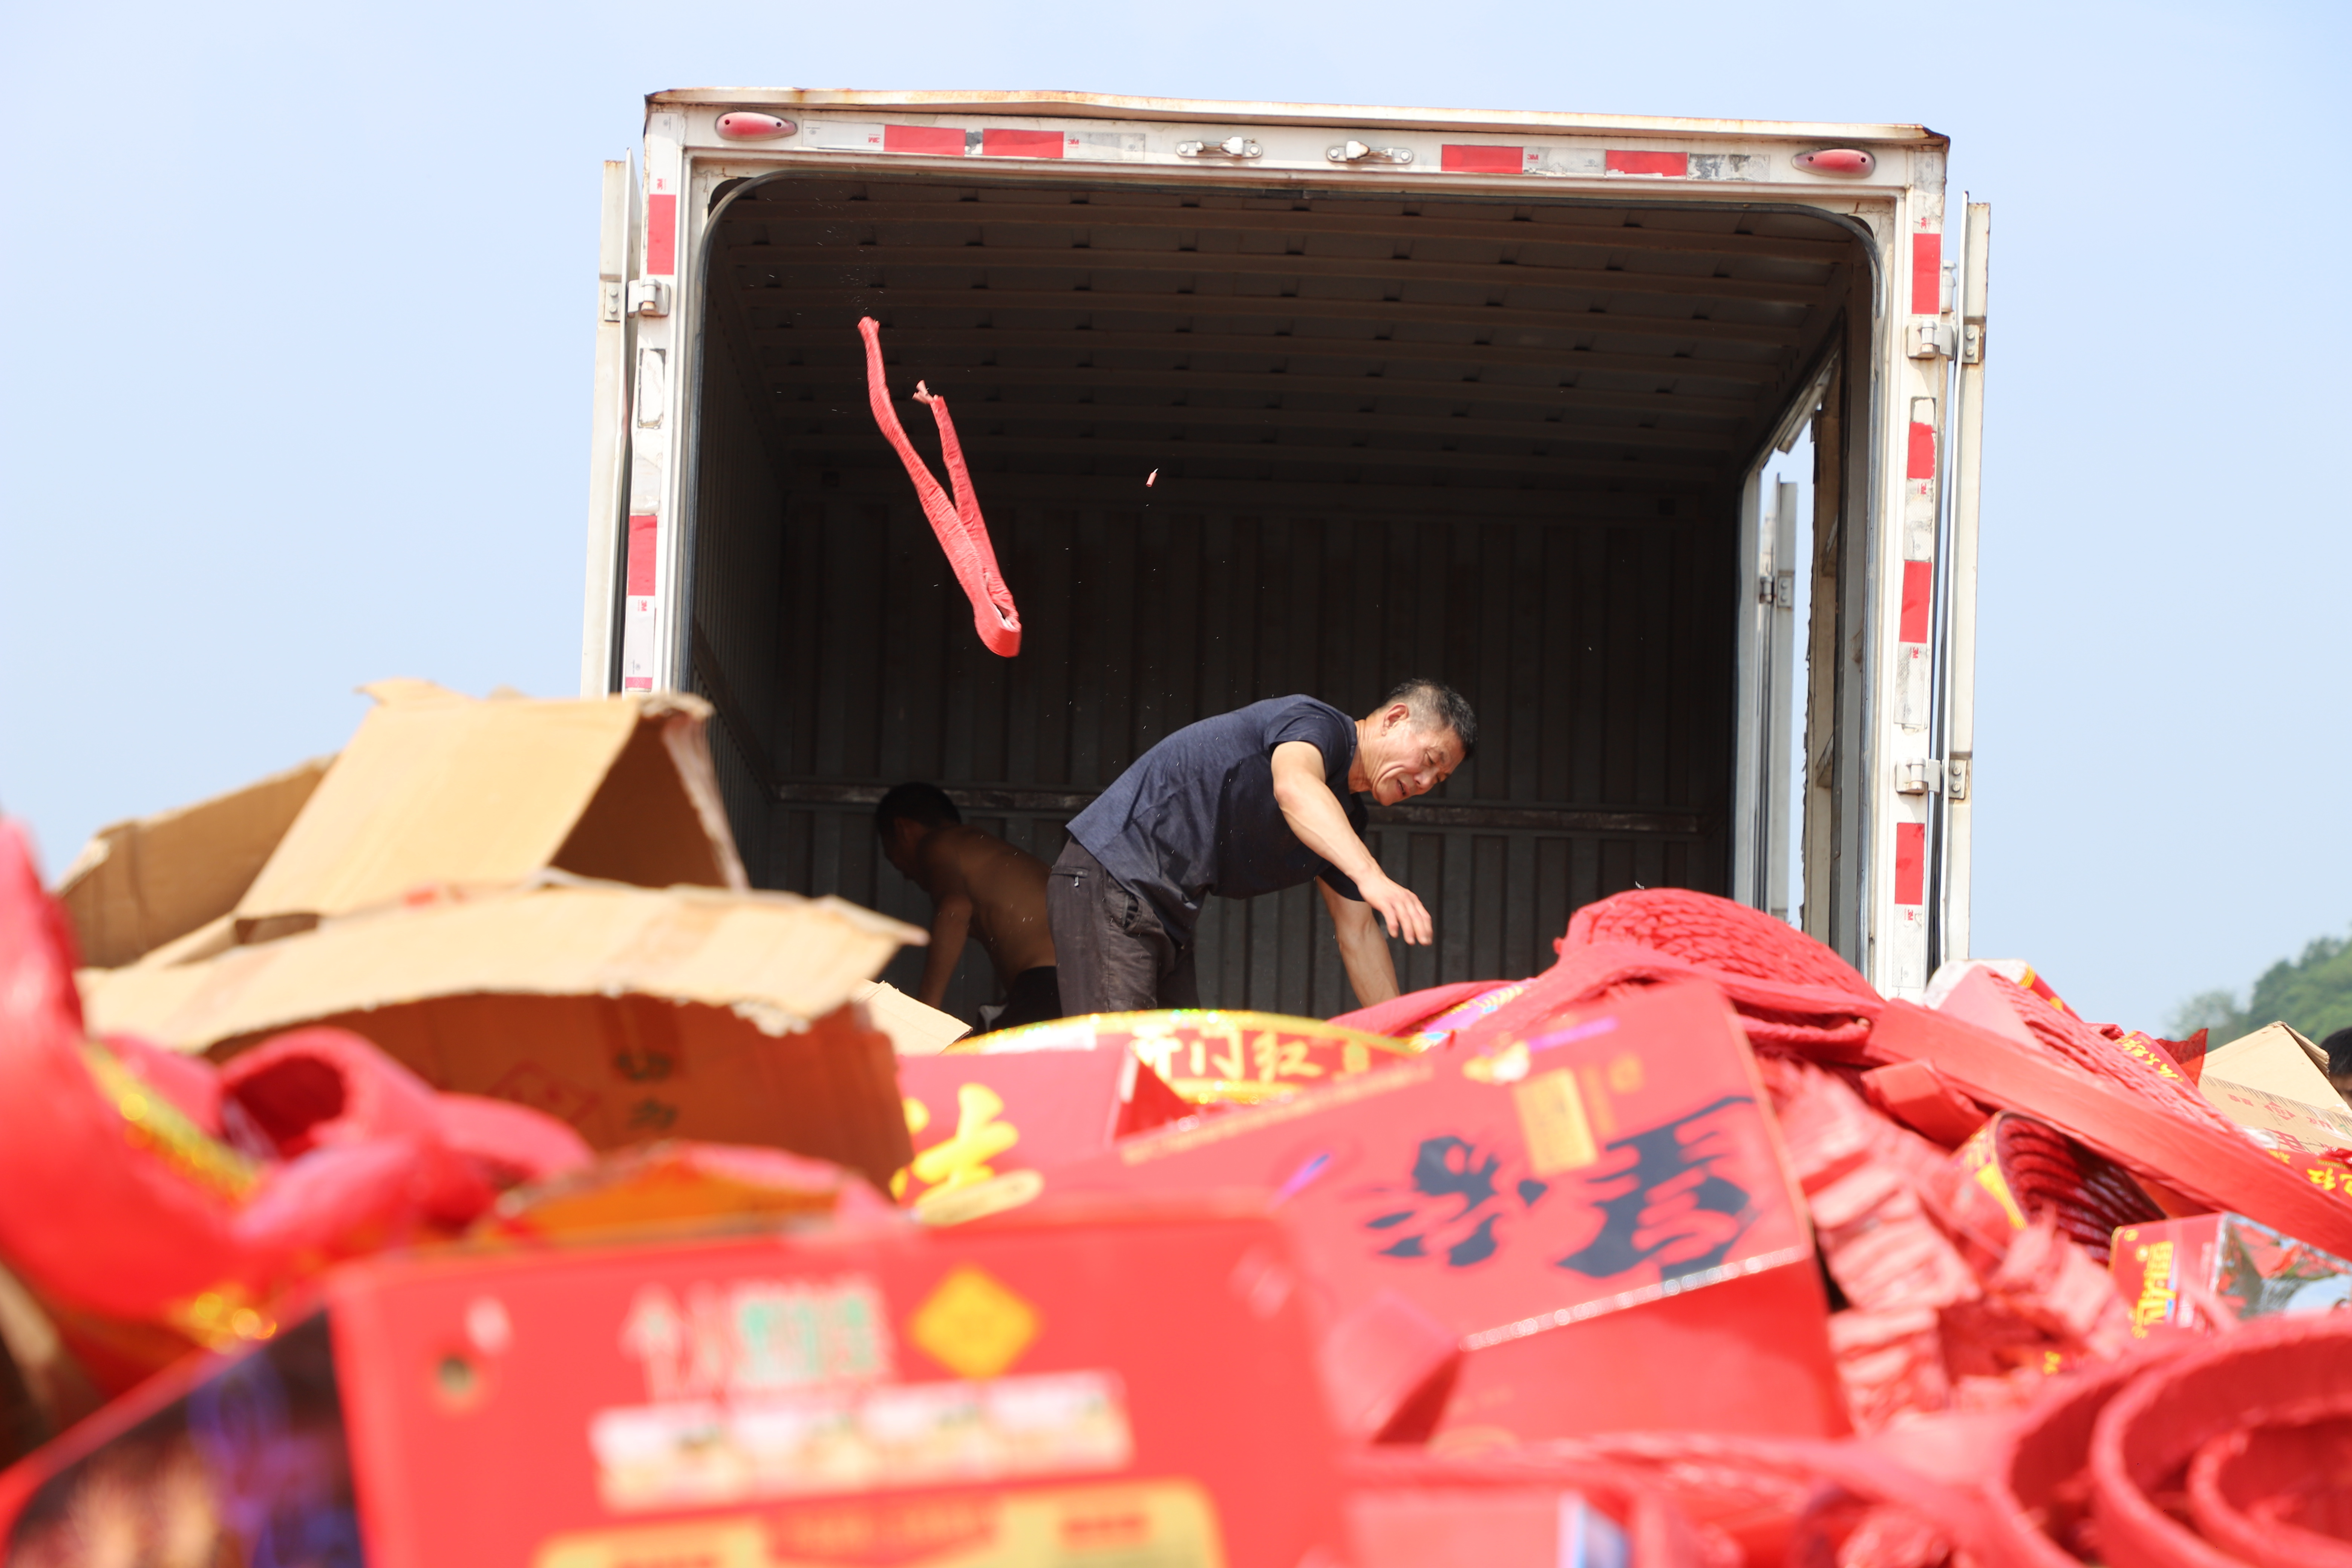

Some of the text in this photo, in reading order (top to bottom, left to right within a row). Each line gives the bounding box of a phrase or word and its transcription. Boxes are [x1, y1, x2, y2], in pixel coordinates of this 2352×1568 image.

[657, 178, 663, 190] 3M
[1920, 217, 1926, 229] 3M
[1921, 483, 1926, 495] 3M
[641, 600, 647, 611] 3M
[1913, 647, 1919, 658] 3M
[1907, 910, 1913, 920] 3M
